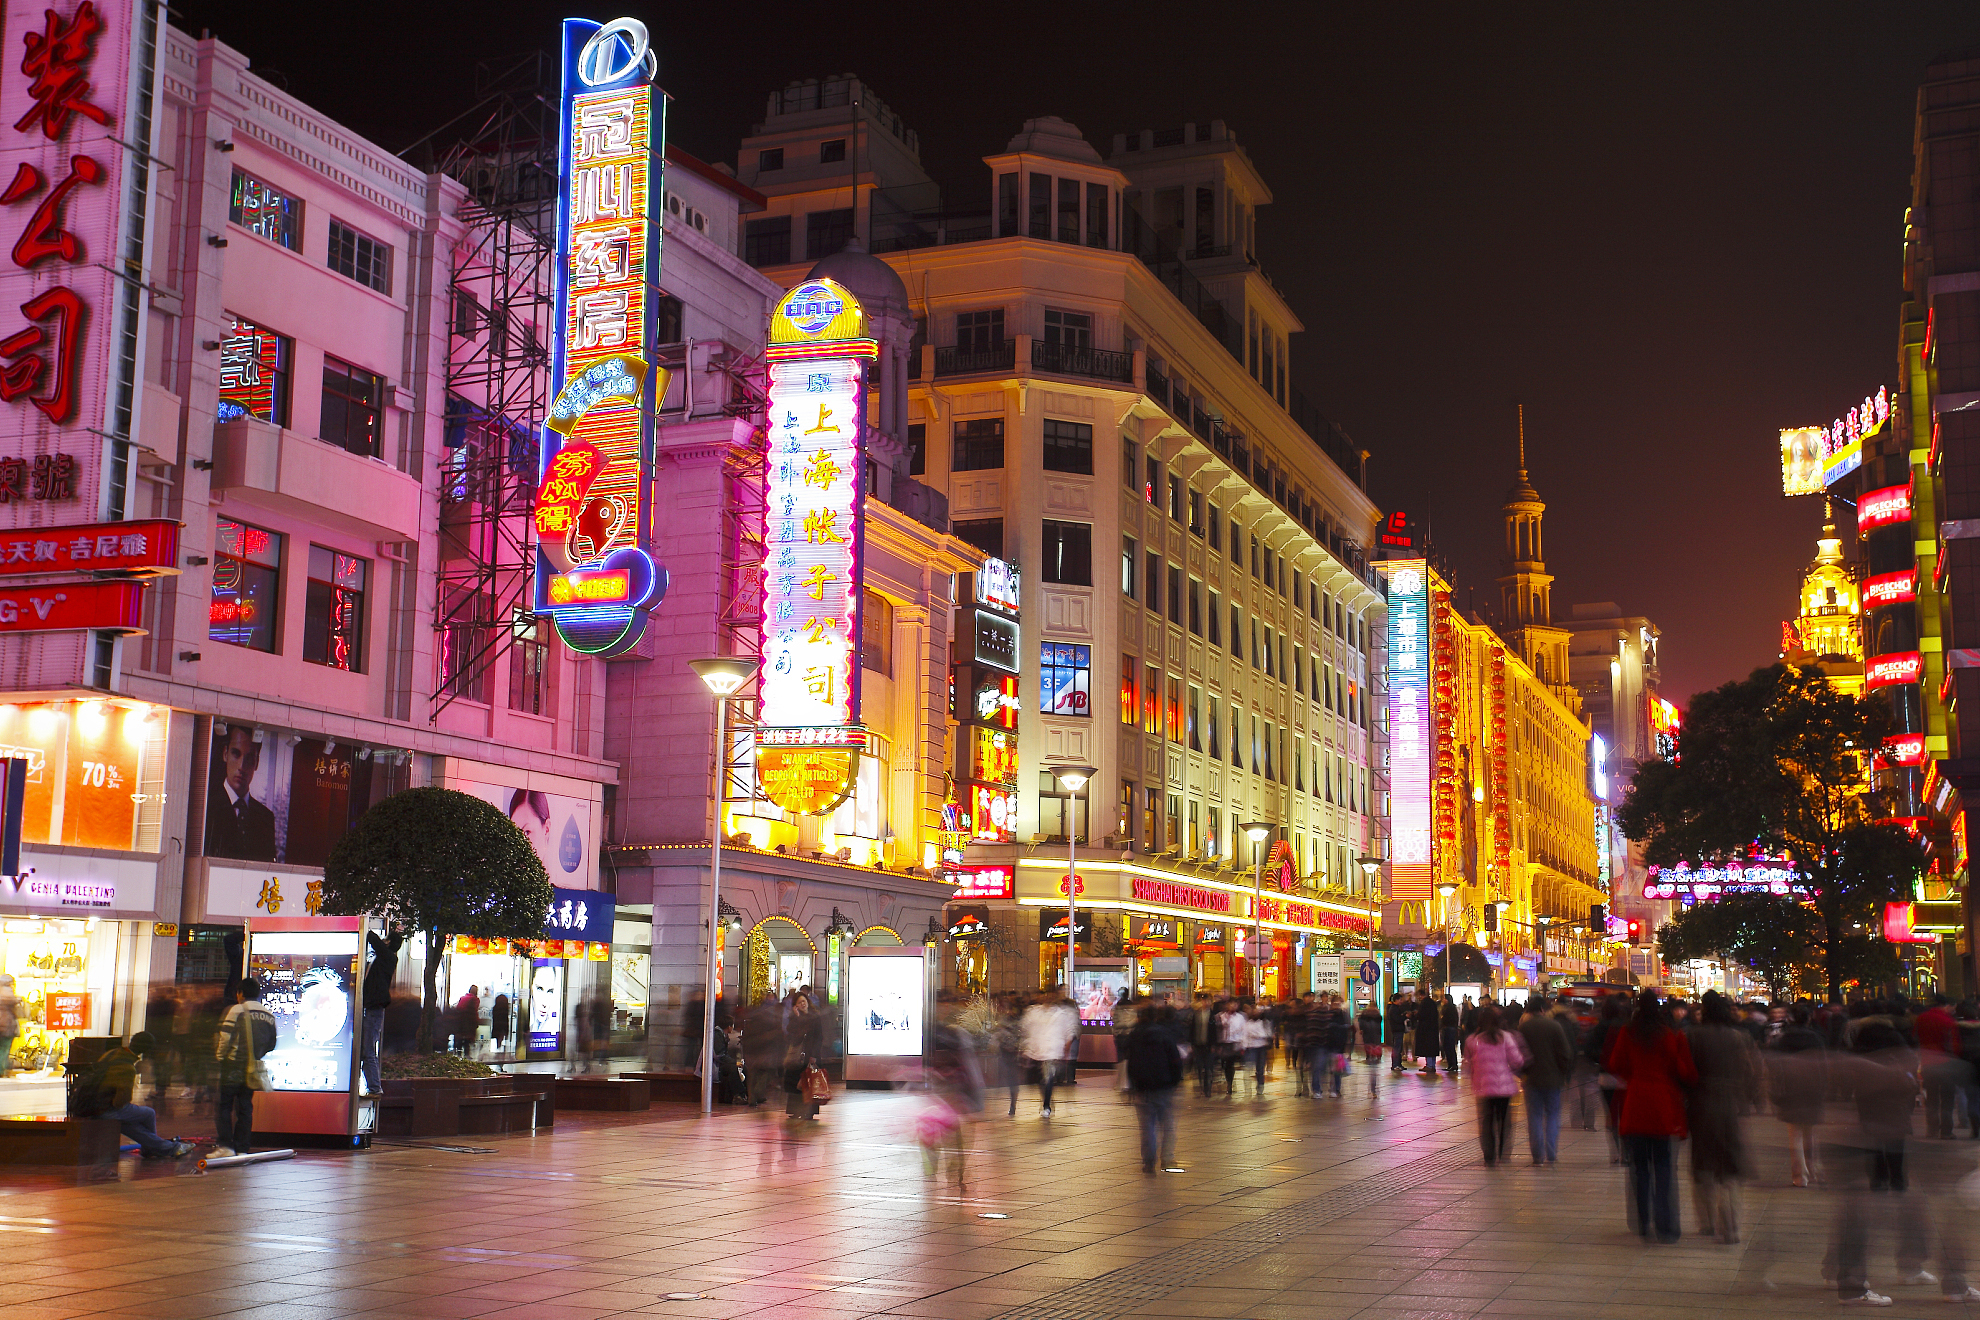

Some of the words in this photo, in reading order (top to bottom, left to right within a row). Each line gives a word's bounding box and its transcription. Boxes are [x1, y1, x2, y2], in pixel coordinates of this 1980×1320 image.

[574, 98, 634, 348] 冠心药房
[536, 451, 592, 532] 芬必得
[1880, 498, 1907, 509] ECHO
[803, 403, 844, 705] 上海帐子公司
[1884, 579, 1911, 591] ECHO
[1889, 660, 1918, 672] ECHO
[1132, 878, 1173, 904] SHANGHAI
[1174, 884, 1192, 906] FIRST
[1192, 887, 1211, 909] FOOD
